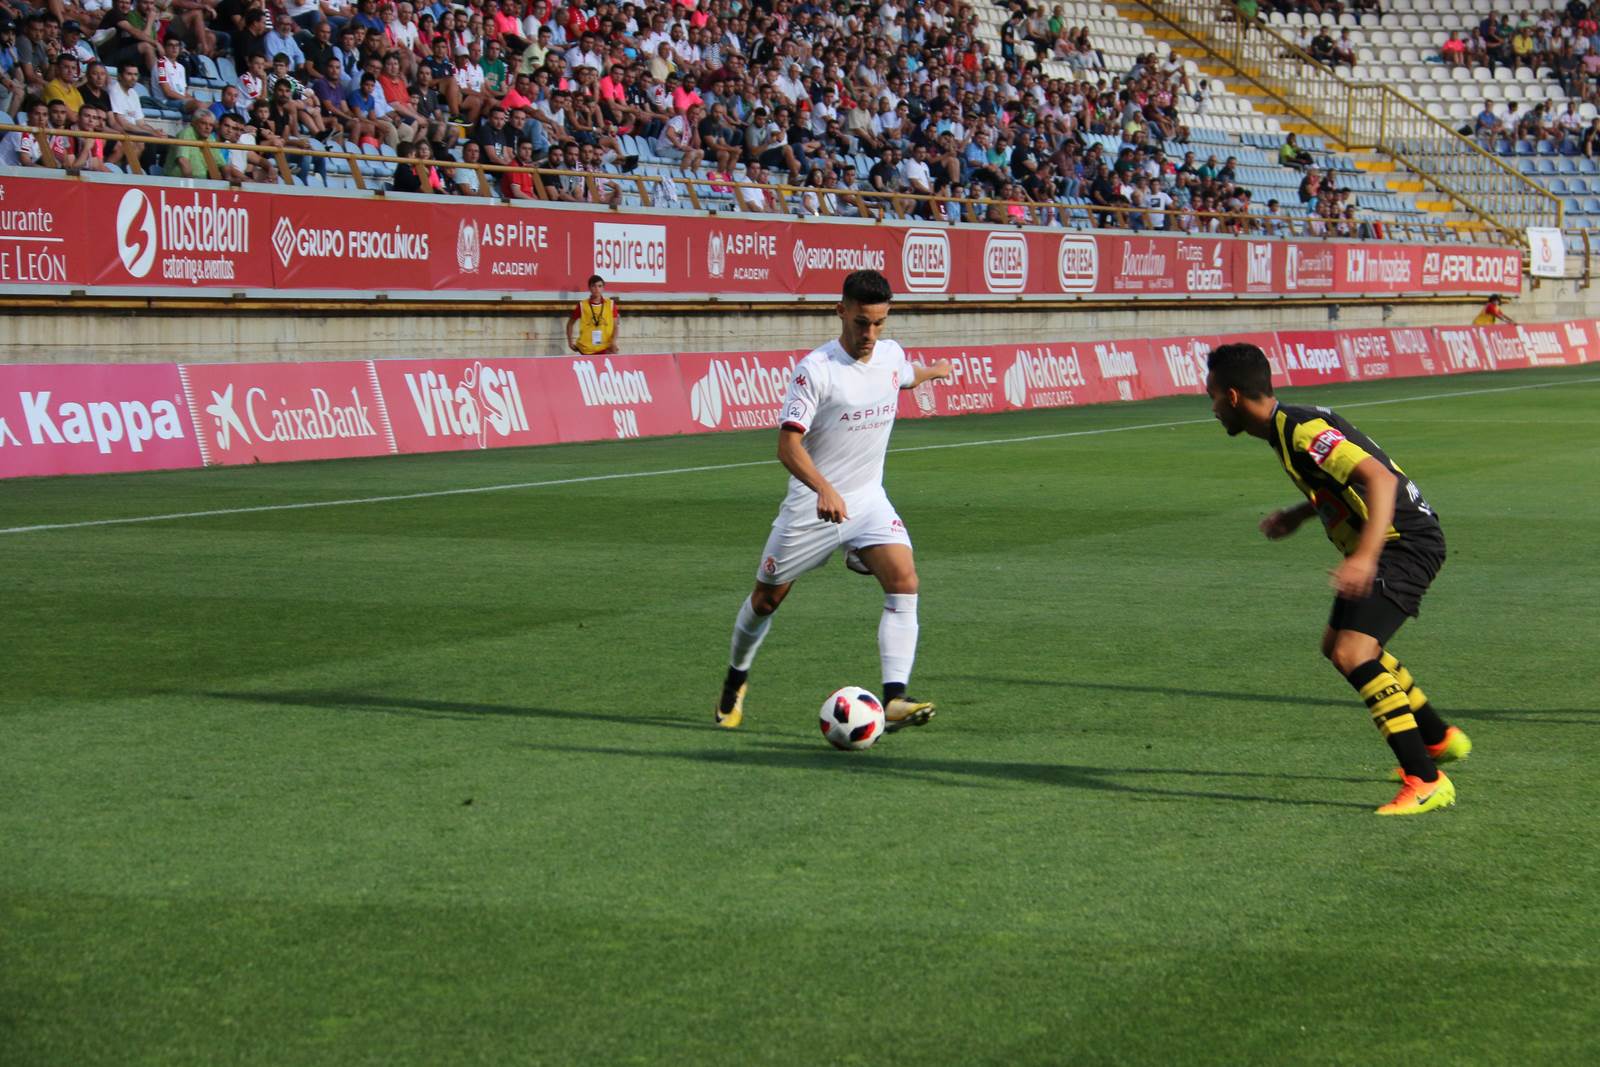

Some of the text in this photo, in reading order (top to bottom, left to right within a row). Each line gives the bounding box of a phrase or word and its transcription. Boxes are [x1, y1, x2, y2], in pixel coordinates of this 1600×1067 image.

[0, 208, 53, 232] urante
[160, 189, 249, 253] hosteleón
[297, 224, 429, 261] GRUPO FISIOCLÍNICAS
[594, 231, 665, 276] aspire.qa
[806, 247, 834, 270] GRUPO
[16, 245, 67, 281] LEÓN
[491, 261, 539, 276] ACADEMY
[733, 267, 770, 281] ACADEMY
[1020, 346, 1087, 389] Nakheel
[1295, 343, 1341, 375] Kappa
[572, 357, 653, 406] Mahou
[246, 386, 377, 442] CaixaBank
[728, 408, 784, 428] LANDSCAP
[946, 393, 995, 411] ACADEMY
[19, 391, 184, 454] Kappa
